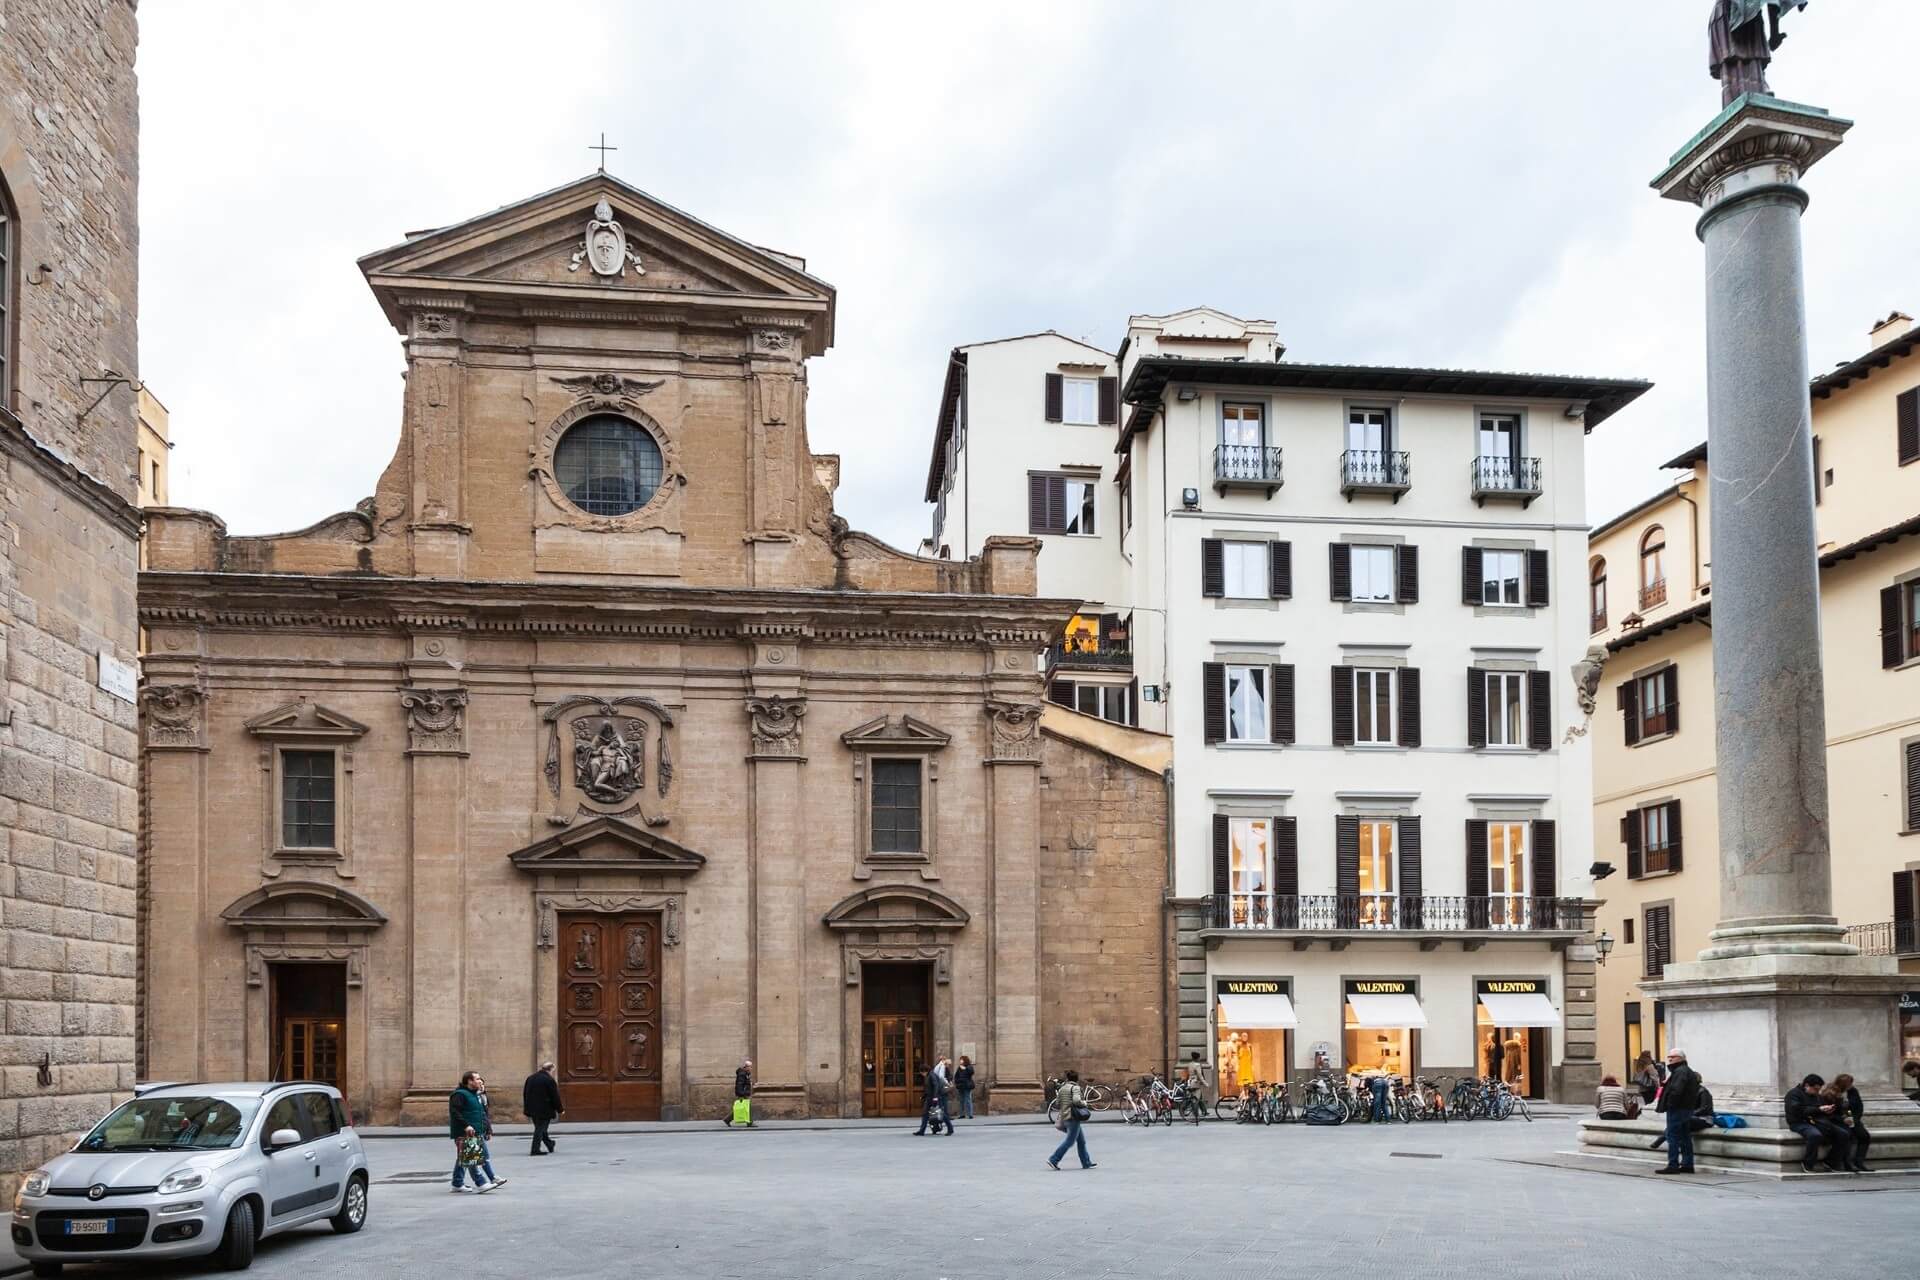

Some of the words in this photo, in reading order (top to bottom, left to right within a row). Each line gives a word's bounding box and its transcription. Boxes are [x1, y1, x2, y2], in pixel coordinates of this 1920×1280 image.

[1228, 983, 1279, 993] VALENTINO
[1356, 983, 1405, 993] VALENTINO
[1487, 982, 1536, 992] VALENTINO
